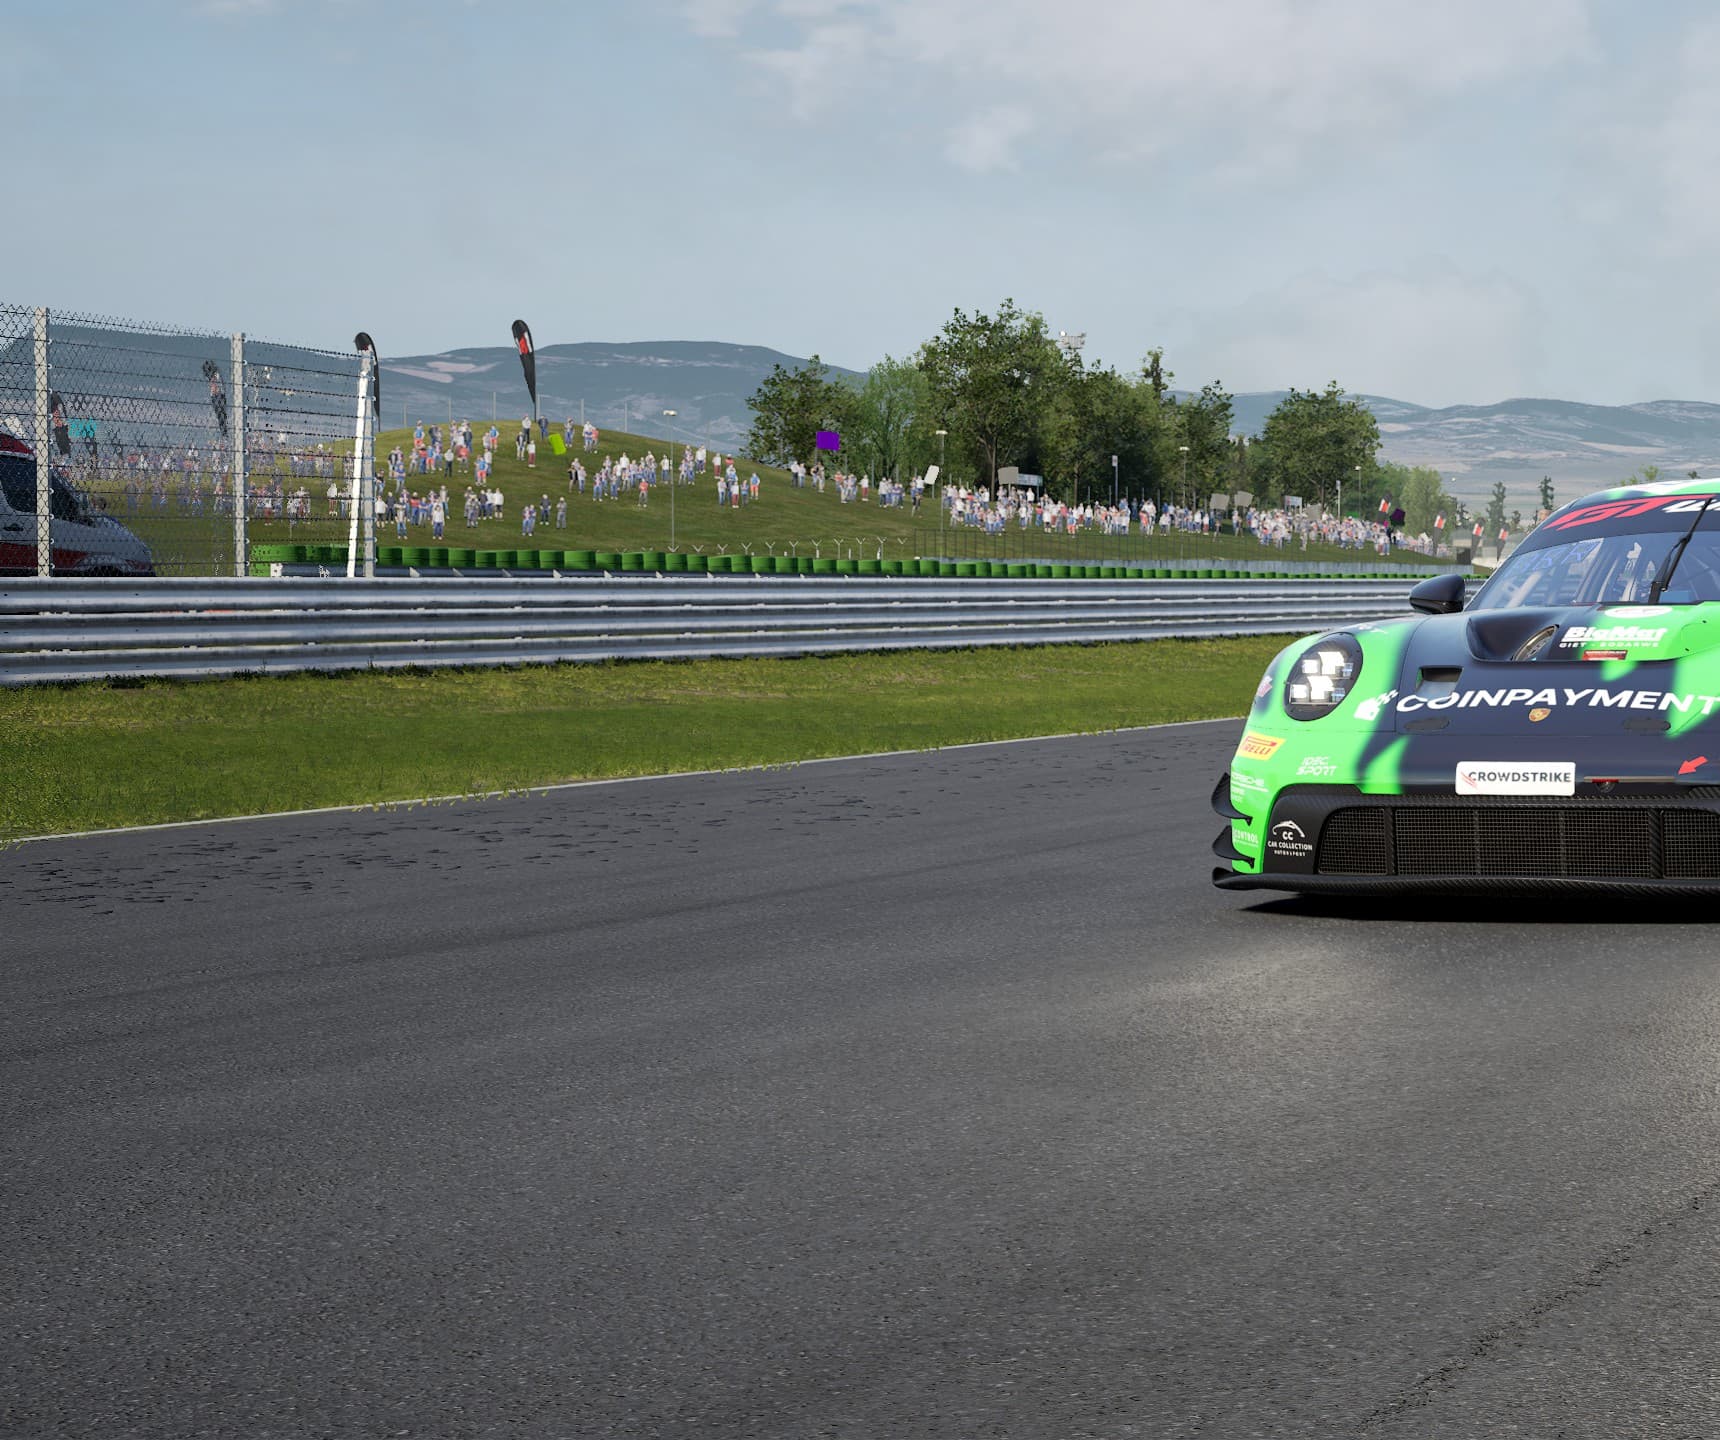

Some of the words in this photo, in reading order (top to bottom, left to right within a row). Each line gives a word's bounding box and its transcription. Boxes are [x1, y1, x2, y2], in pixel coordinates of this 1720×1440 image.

[1468, 770, 1572, 784] CROWDSTRIKE
[1282, 831, 1294, 841] CC
[1267, 840, 1278, 848] CAR
[1279, 841, 1313, 851] COLLECTION
